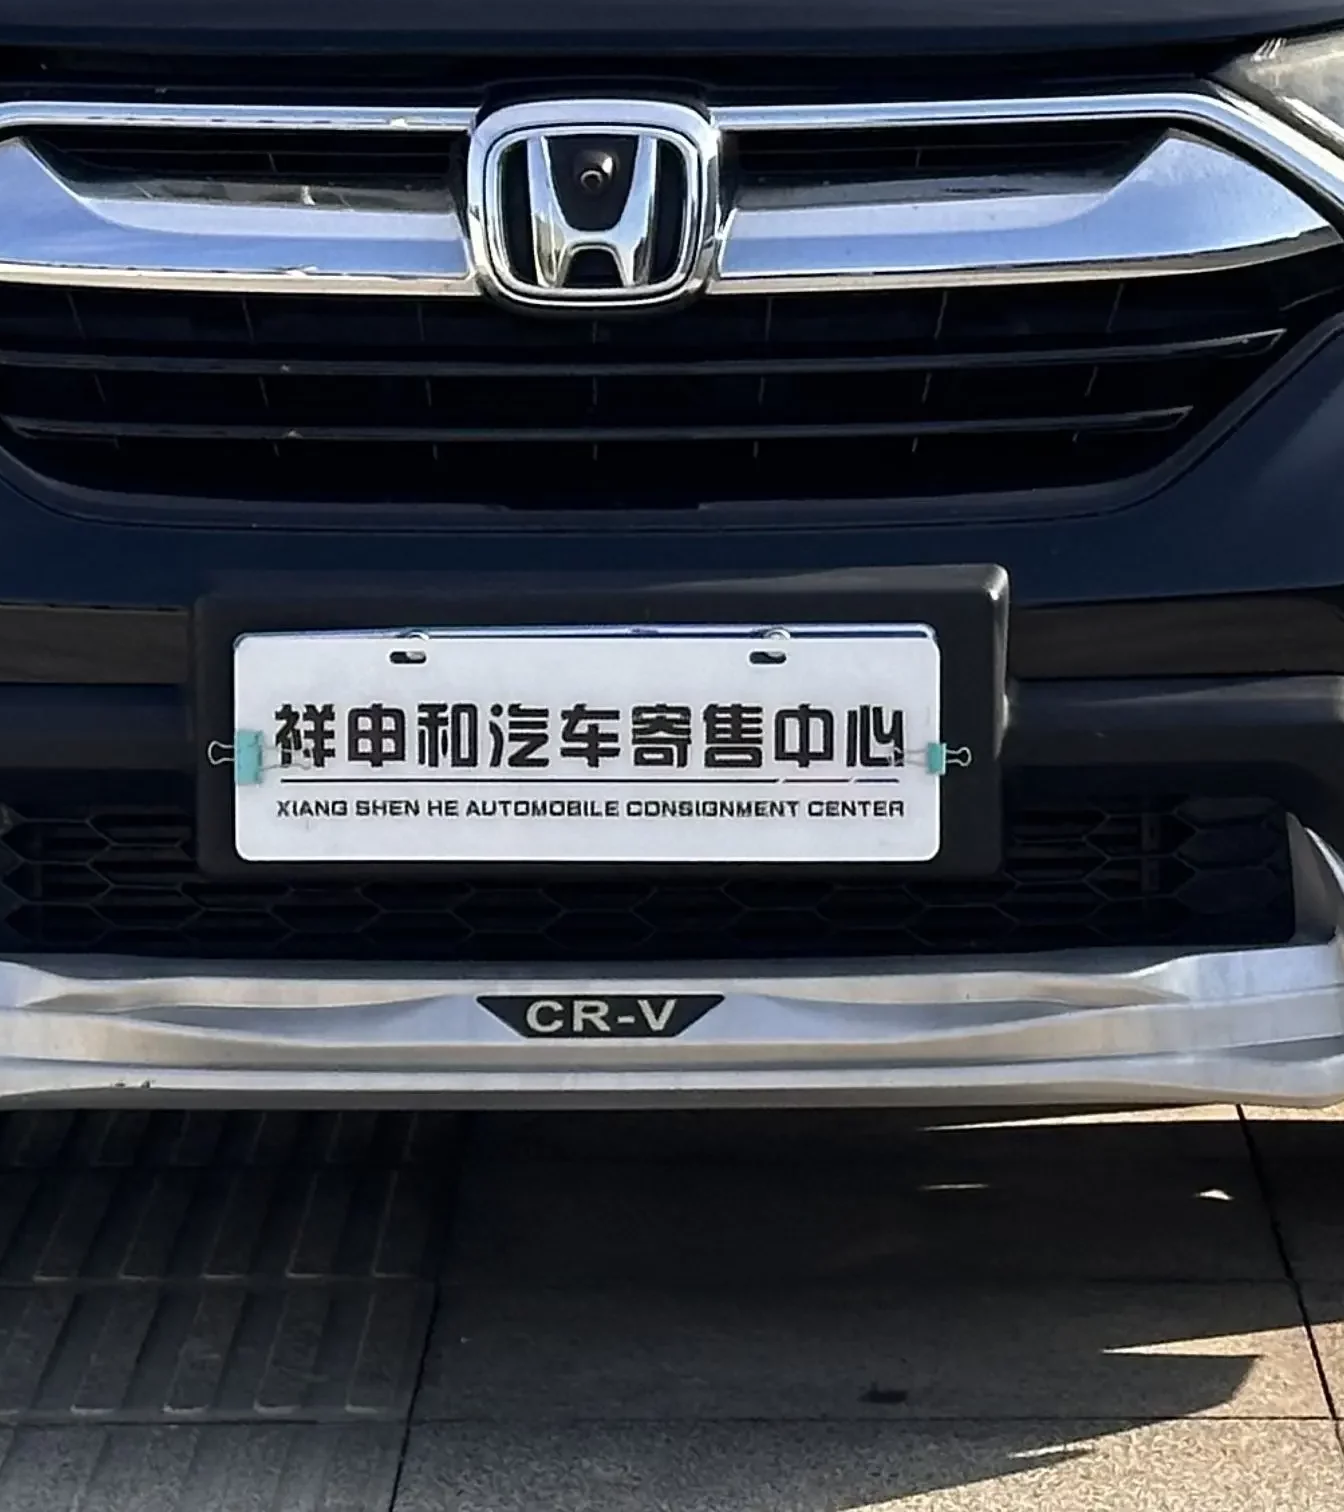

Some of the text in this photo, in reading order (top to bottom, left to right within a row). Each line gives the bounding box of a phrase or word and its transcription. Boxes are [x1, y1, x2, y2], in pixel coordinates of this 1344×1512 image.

[275, 703, 905, 768] 祥申和汽车寄售中心
[276, 799, 905, 818] XIANG SHEN HE AUTOMOBILE CONSIGNMENT CENTER
[526, 998, 678, 1034] CR-V
